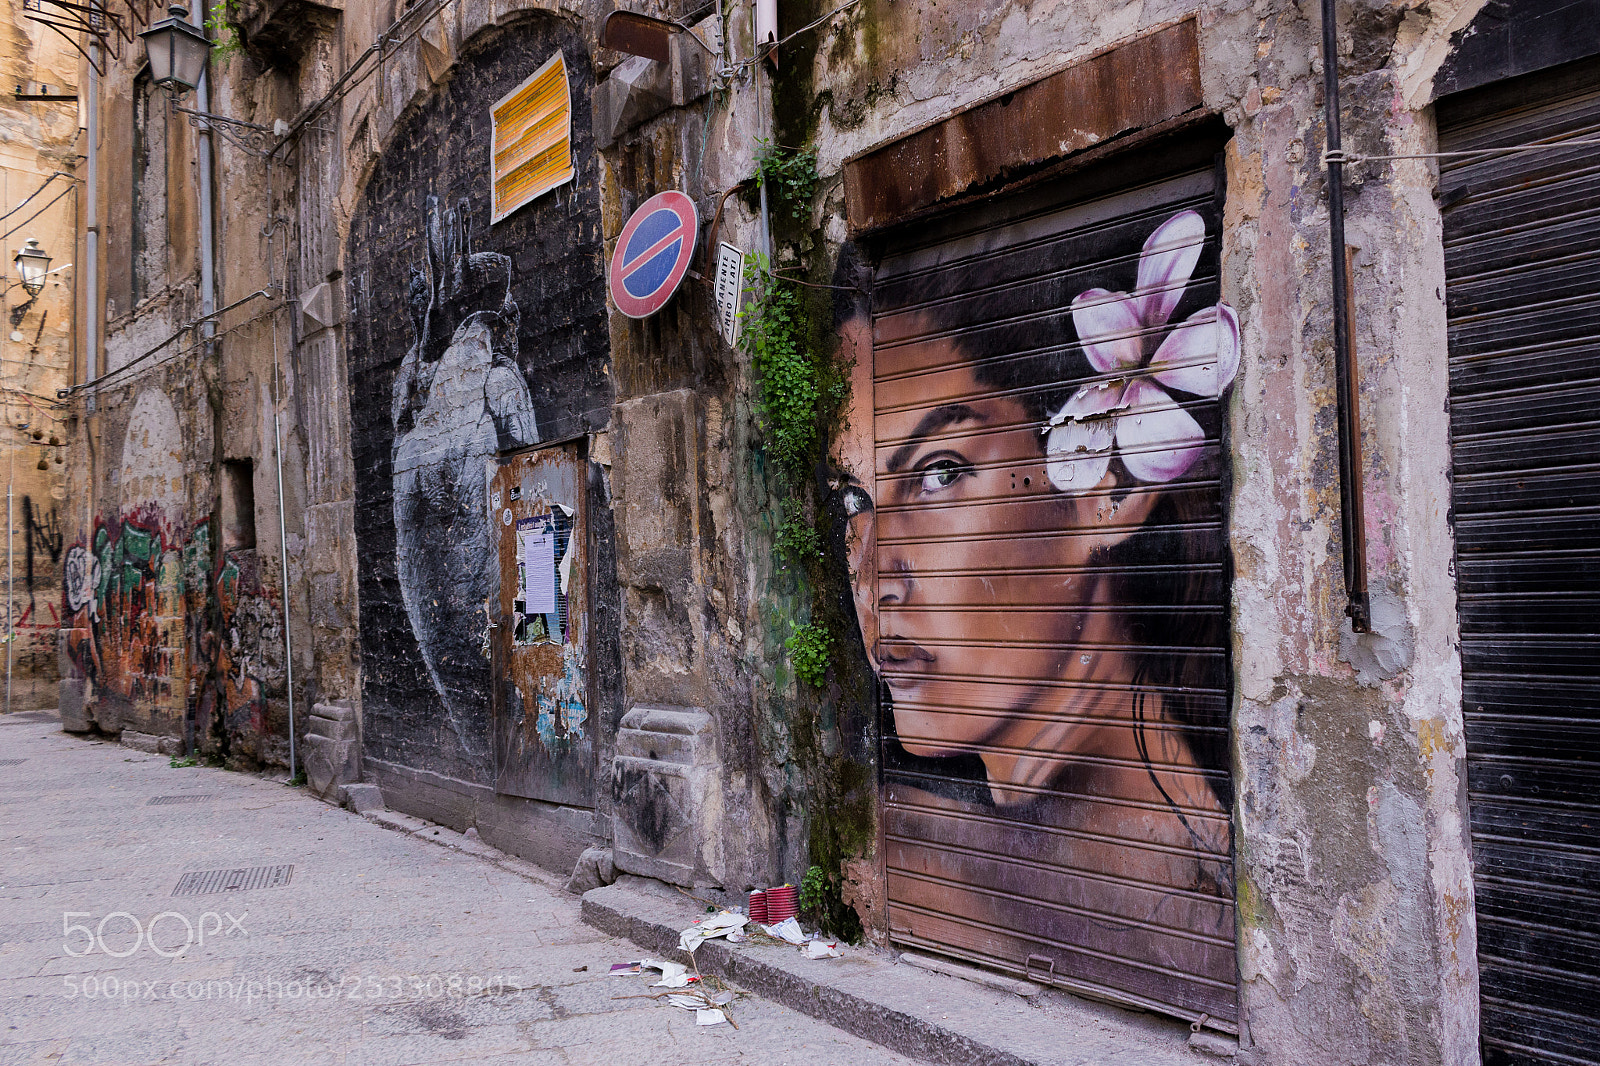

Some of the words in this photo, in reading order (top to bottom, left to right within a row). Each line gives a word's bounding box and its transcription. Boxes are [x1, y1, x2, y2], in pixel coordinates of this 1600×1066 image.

[718, 254, 729, 312] MANENTE
[724, 302, 733, 335] AMBO
[729, 259, 737, 286] LATI
